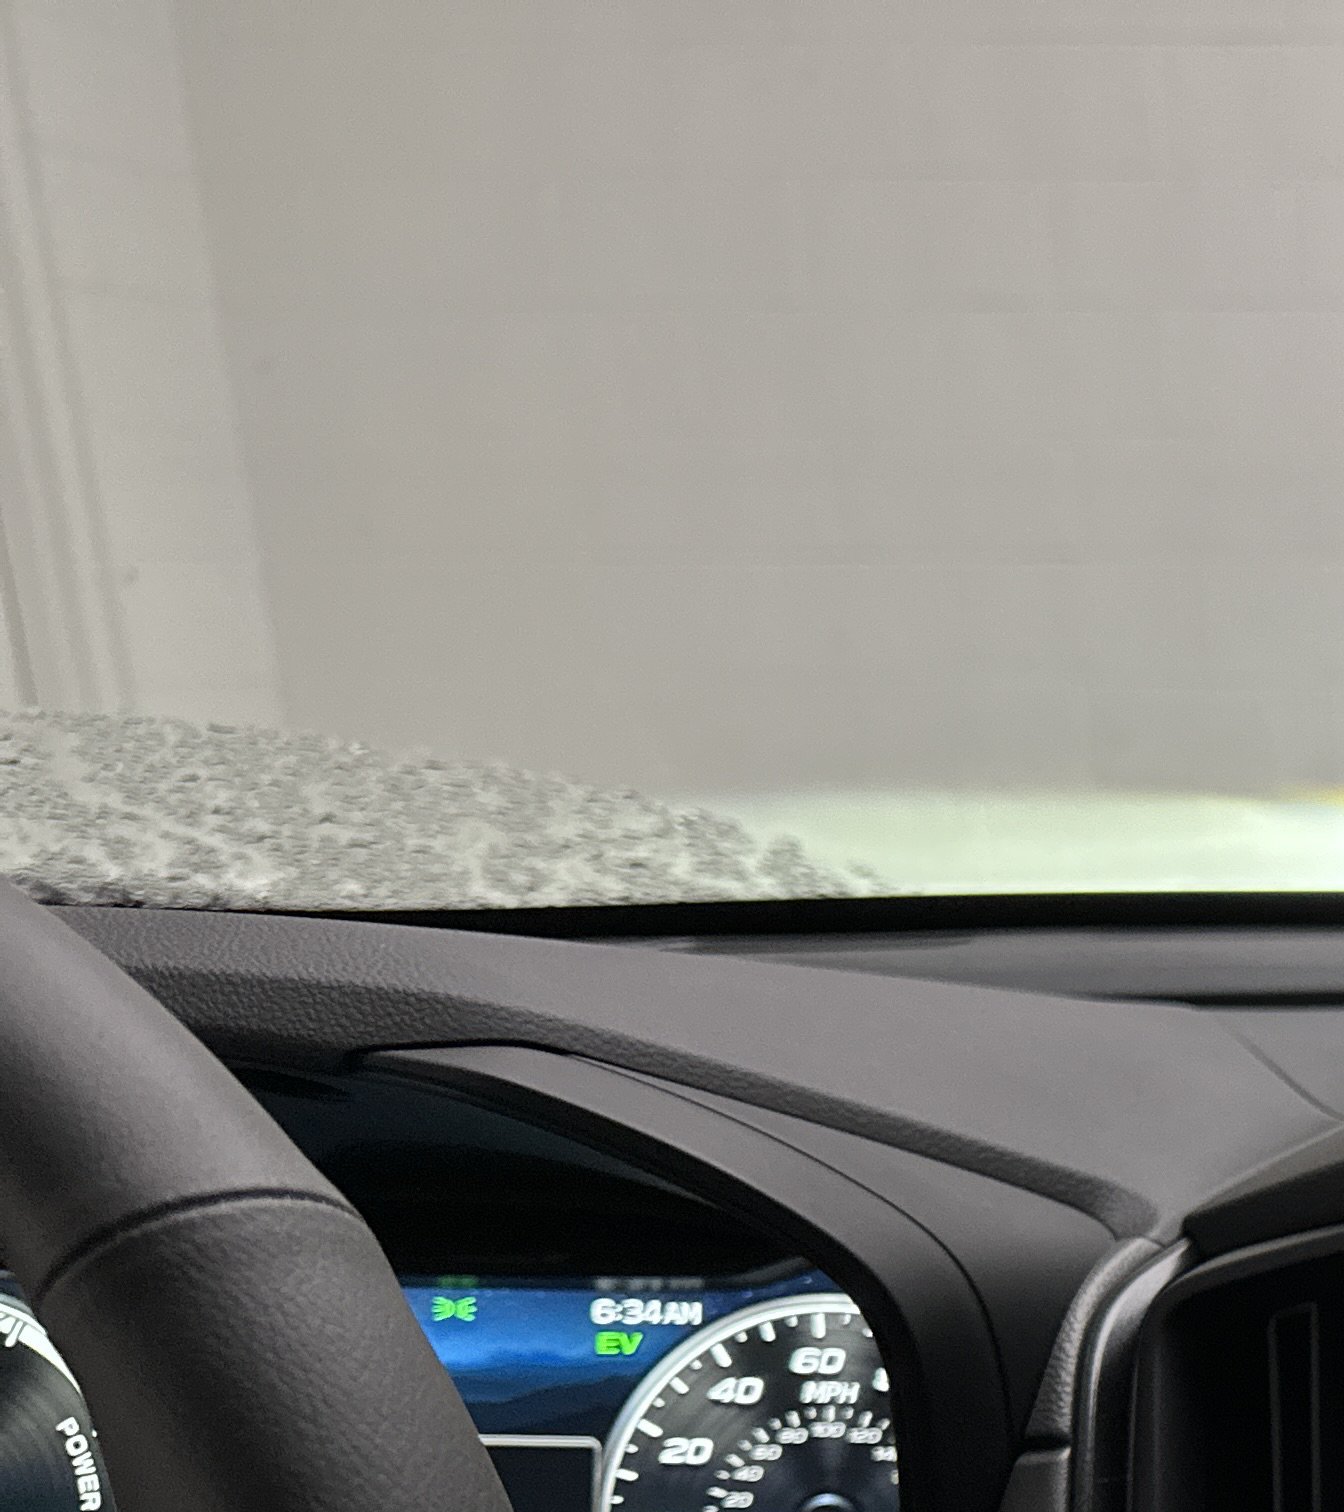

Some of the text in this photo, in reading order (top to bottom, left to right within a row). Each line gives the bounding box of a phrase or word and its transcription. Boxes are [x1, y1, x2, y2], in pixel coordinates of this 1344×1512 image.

[594, 1331, 643, 1355] EV
[788, 1346, 847, 1375] 60
[706, 1376, 765, 1405] 40
[800, 1379, 861, 1404] MPH
[56, 1416, 102, 1512] POWER
[658, 1437, 714, 1465] 20
